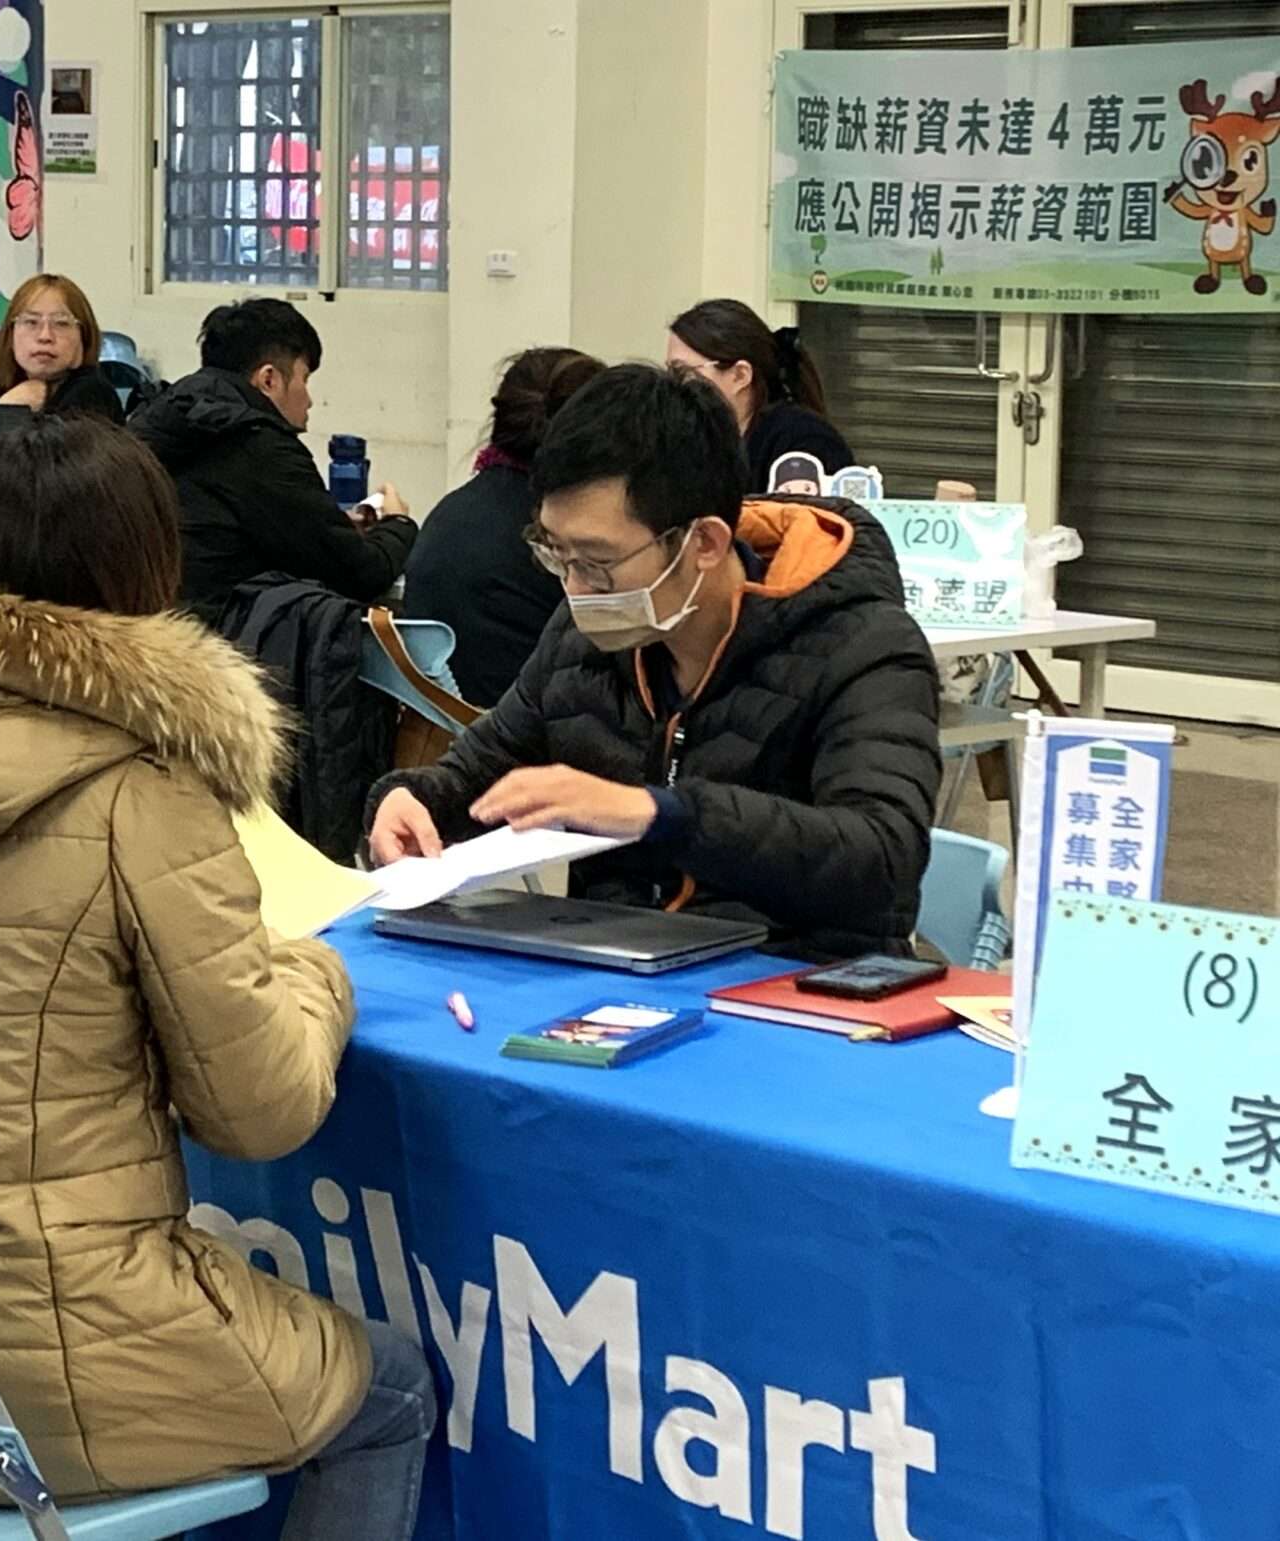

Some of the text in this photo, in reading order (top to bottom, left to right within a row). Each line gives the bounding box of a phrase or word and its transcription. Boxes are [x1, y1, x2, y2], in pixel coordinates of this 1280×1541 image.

[797, 95, 1166, 156] 職缺薪資未達4萬元
[795, 178, 1158, 242] 應公開揭示薪資範圍
[903, 518, 959, 549] (20)
[1184, 950, 1259, 1024] (8)
